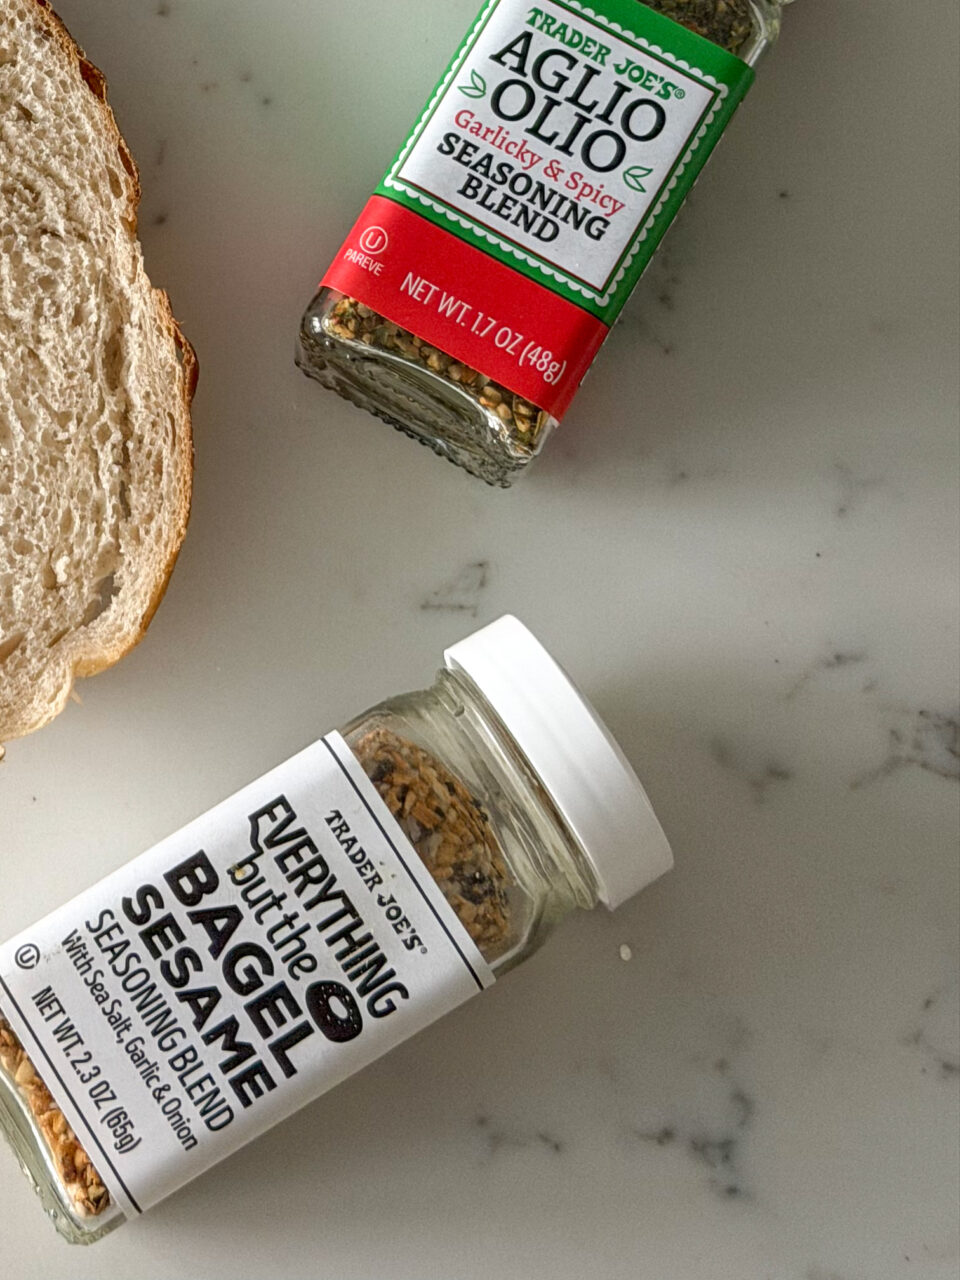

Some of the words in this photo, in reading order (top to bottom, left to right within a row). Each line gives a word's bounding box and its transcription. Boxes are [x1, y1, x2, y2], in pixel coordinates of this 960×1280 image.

[525, 7, 612, 67] TRADER
[488, 30, 667, 142] AGLIO
[490, 78, 627, 173] OLIO
[436, 132, 612, 242] SEASONING
[454, 109, 543, 171] Garlicky
[543, 159, 565, 182] &
[565, 171, 626, 218] Spicy
[457, 173, 560, 243] BLEND
[343, 248, 385, 277] PAREVE
[400, 271, 440, 306] NET
[437, 291, 473, 327] WT.
[470, 312, 497, 338] 1.7
[494, 327, 524, 356] OZ
[518, 340, 568, 386] (48g)
[324, 809, 384, 894] TRADER
[226, 851, 288, 926] but
[266, 911, 318, 981] the
[247, 794, 410, 1019] EVERYTHING
[60, 928, 93, 979] With
[162, 849, 316, 1080] BAGEL
[31, 985, 66, 1023] NET
[84, 969, 110, 1006] Sea
[121, 883, 278, 1109] SESAME
[52, 1017, 85, 1058] WT.
[85, 908, 187, 1053] SEASONING
[167, 1044, 235, 1132] BLEND
[101, 998, 134, 1044] Salt,
[70, 1050, 102, 1085] 2.3
[124, 1036, 161, 1090] Garlic
[89, 1078, 118, 1111] OZ
[152, 1082, 172, 1105] &
[99, 1105, 143, 1155] (65g)
[161, 1097, 199, 1152] Onion
